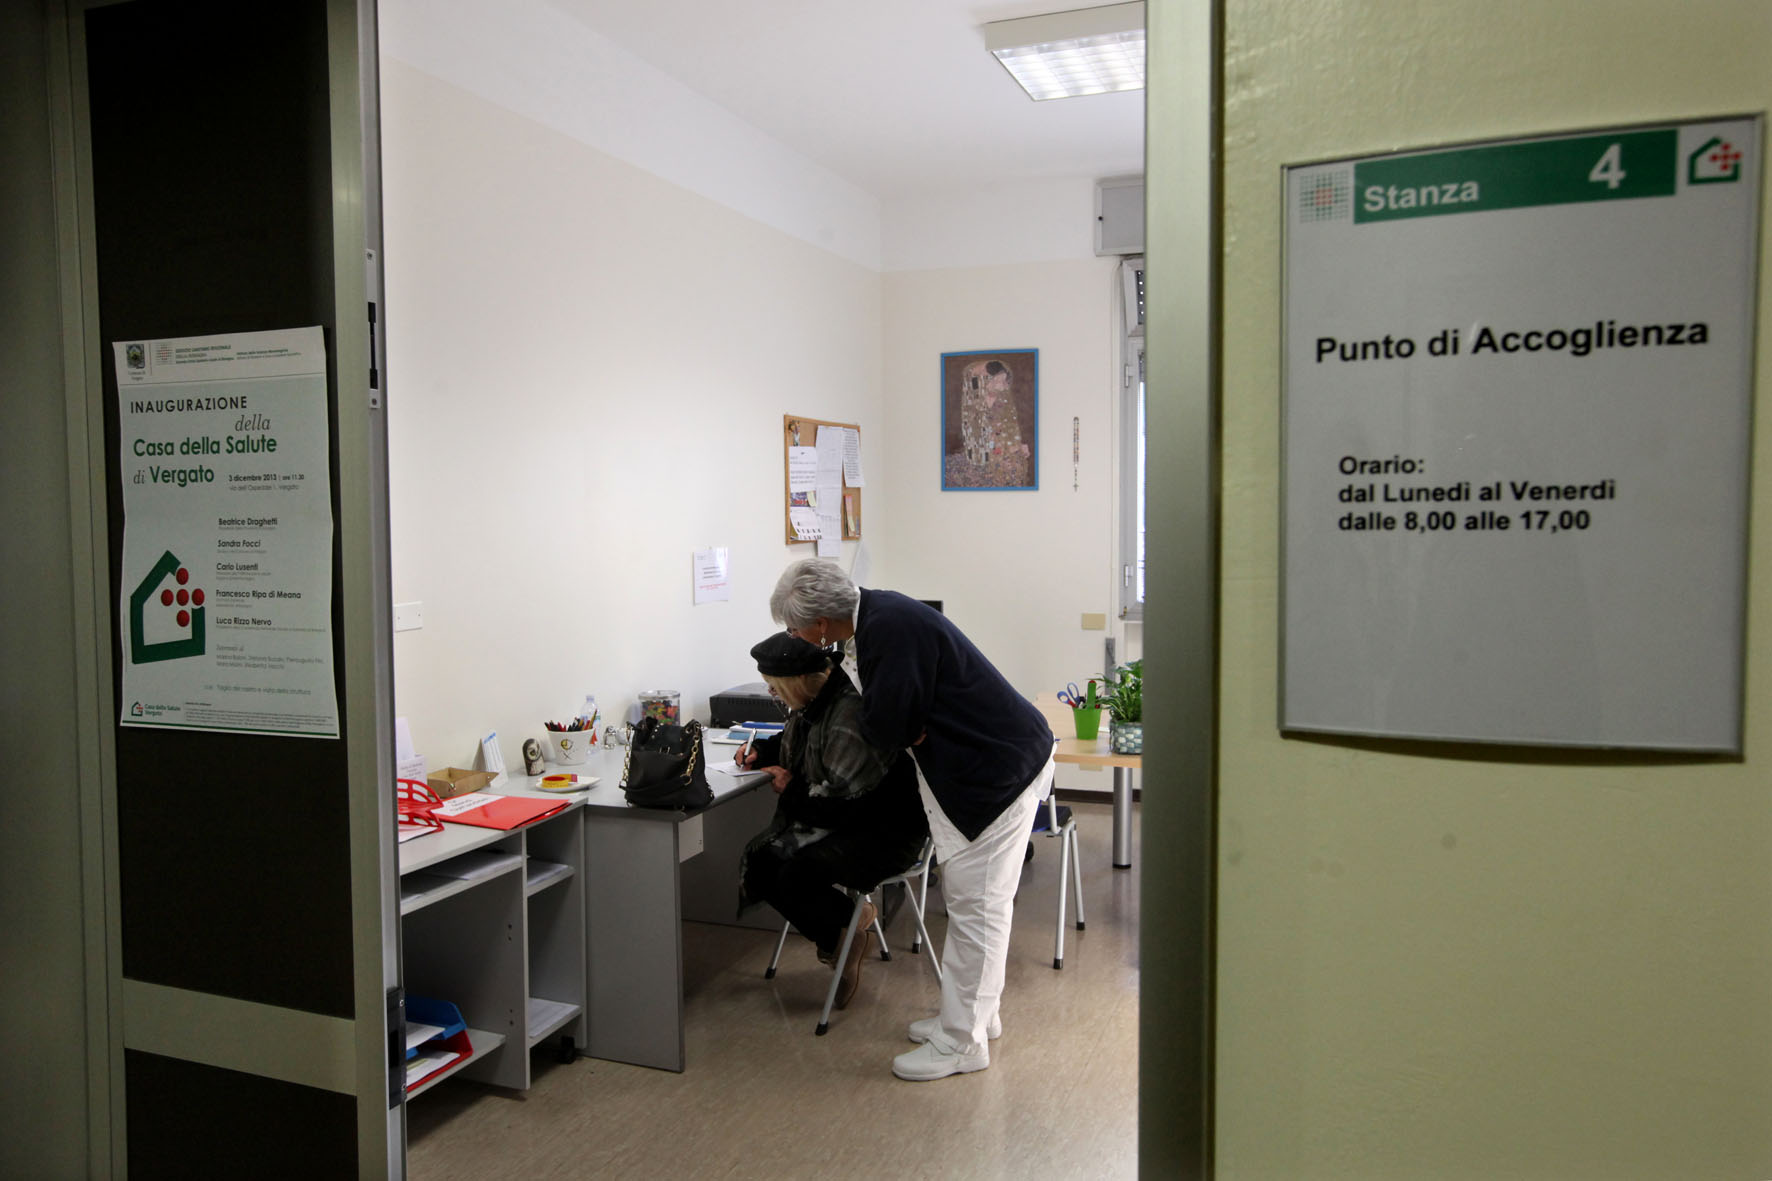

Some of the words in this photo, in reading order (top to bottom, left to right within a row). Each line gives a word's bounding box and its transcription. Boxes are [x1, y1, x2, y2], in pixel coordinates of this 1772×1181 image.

[1363, 178, 1479, 213] Stanza
[1588, 143, 1626, 188] 4
[1315, 333, 1415, 363] Punto
[1428, 329, 1459, 355] di
[1472, 320, 1709, 357] Accoglienza
[130, 396, 247, 414] INAUGURAZIONE
[234, 414, 271, 431] della
[133, 438, 174, 456] Casa
[179, 437, 220, 455] della
[225, 434, 277, 454] Salute
[1339, 455, 1424, 475] Orario:
[133, 470, 145, 484] di
[150, 465, 214, 488] Vergato
[228, 474, 232, 482] 3
[233, 474, 262, 482] dicembre
[263, 473, 277, 481] 2013
[1338, 484, 1375, 502] dal
[1479, 481, 1501, 501] al
[218, 518, 246, 526] Beatrice
[247, 518, 278, 527] Draghetti
[1338, 511, 1396, 531] dalle
[1404, 511, 1456, 534] 8,00
[1464, 510, 1511, 531] alle
[1520, 509, 1591, 534] 17,00
[217, 540, 241, 548] Sandra
[242, 540, 261, 548] Focci
[216, 563, 235, 571] Carlo
[236, 563, 259, 571] Lusenti
[216, 589, 250, 598] Francesco
[252, 590, 267, 599] Ripa
[268, 590, 276, 598] di
[277, 590, 302, 599] Meana
[216, 616, 232, 625] Luca
[233, 617, 250, 625] Rizzo
[251, 618, 272, 626] Nervo
